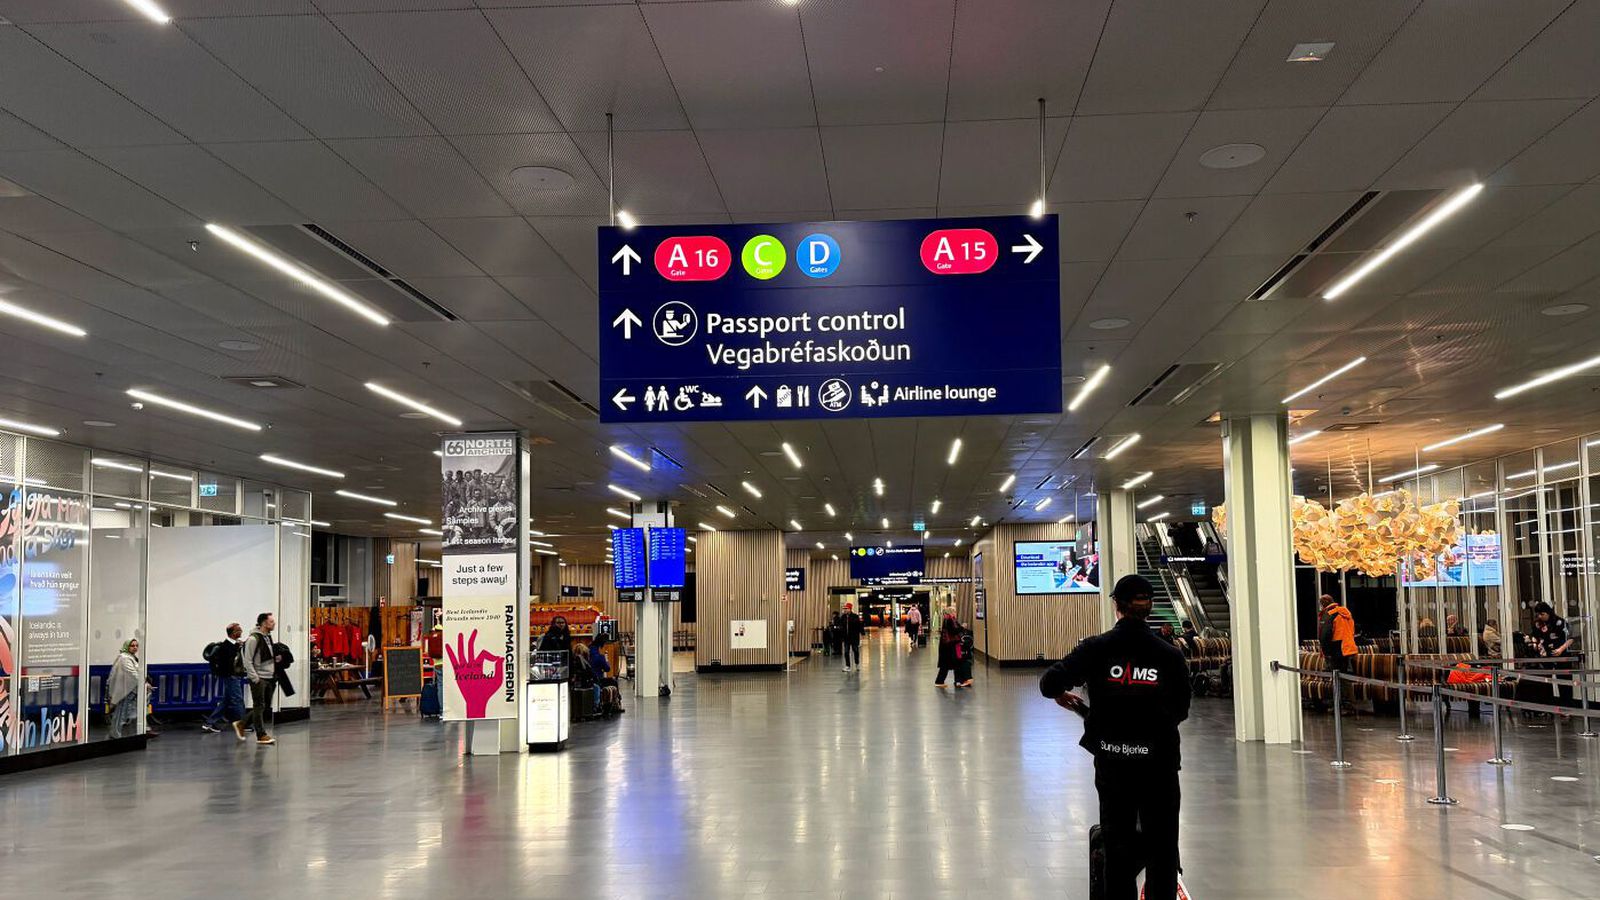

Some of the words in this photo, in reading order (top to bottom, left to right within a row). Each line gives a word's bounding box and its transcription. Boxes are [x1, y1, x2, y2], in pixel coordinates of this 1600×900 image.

[668, 243, 689, 268] A
[694, 249, 719, 268] 16
[754, 241, 772, 266] C
[810, 241, 830, 265] D
[933, 236, 955, 261] A
[961, 241, 986, 260] 15
[706, 312, 811, 338] Passport
[817, 307, 905, 331] control
[706, 339, 911, 370] Vegabréfaskoðun
[685, 385, 699, 393] WC
[893, 385, 942, 400] Airline
[945, 384, 997, 402] lounge
[446, 441, 464, 455] 66
[466, 439, 512, 448] NORTH
[460, 505, 487, 513] Archive
[456, 565, 477, 573] Just
[487, 563, 504, 572] few
[452, 577, 478, 586] steps
[480, 574, 508, 585] away!
[455, 670, 494, 681] Iceland
[1100, 740, 1121, 753] Sune
[1122, 744, 1149, 756] Bjerke
